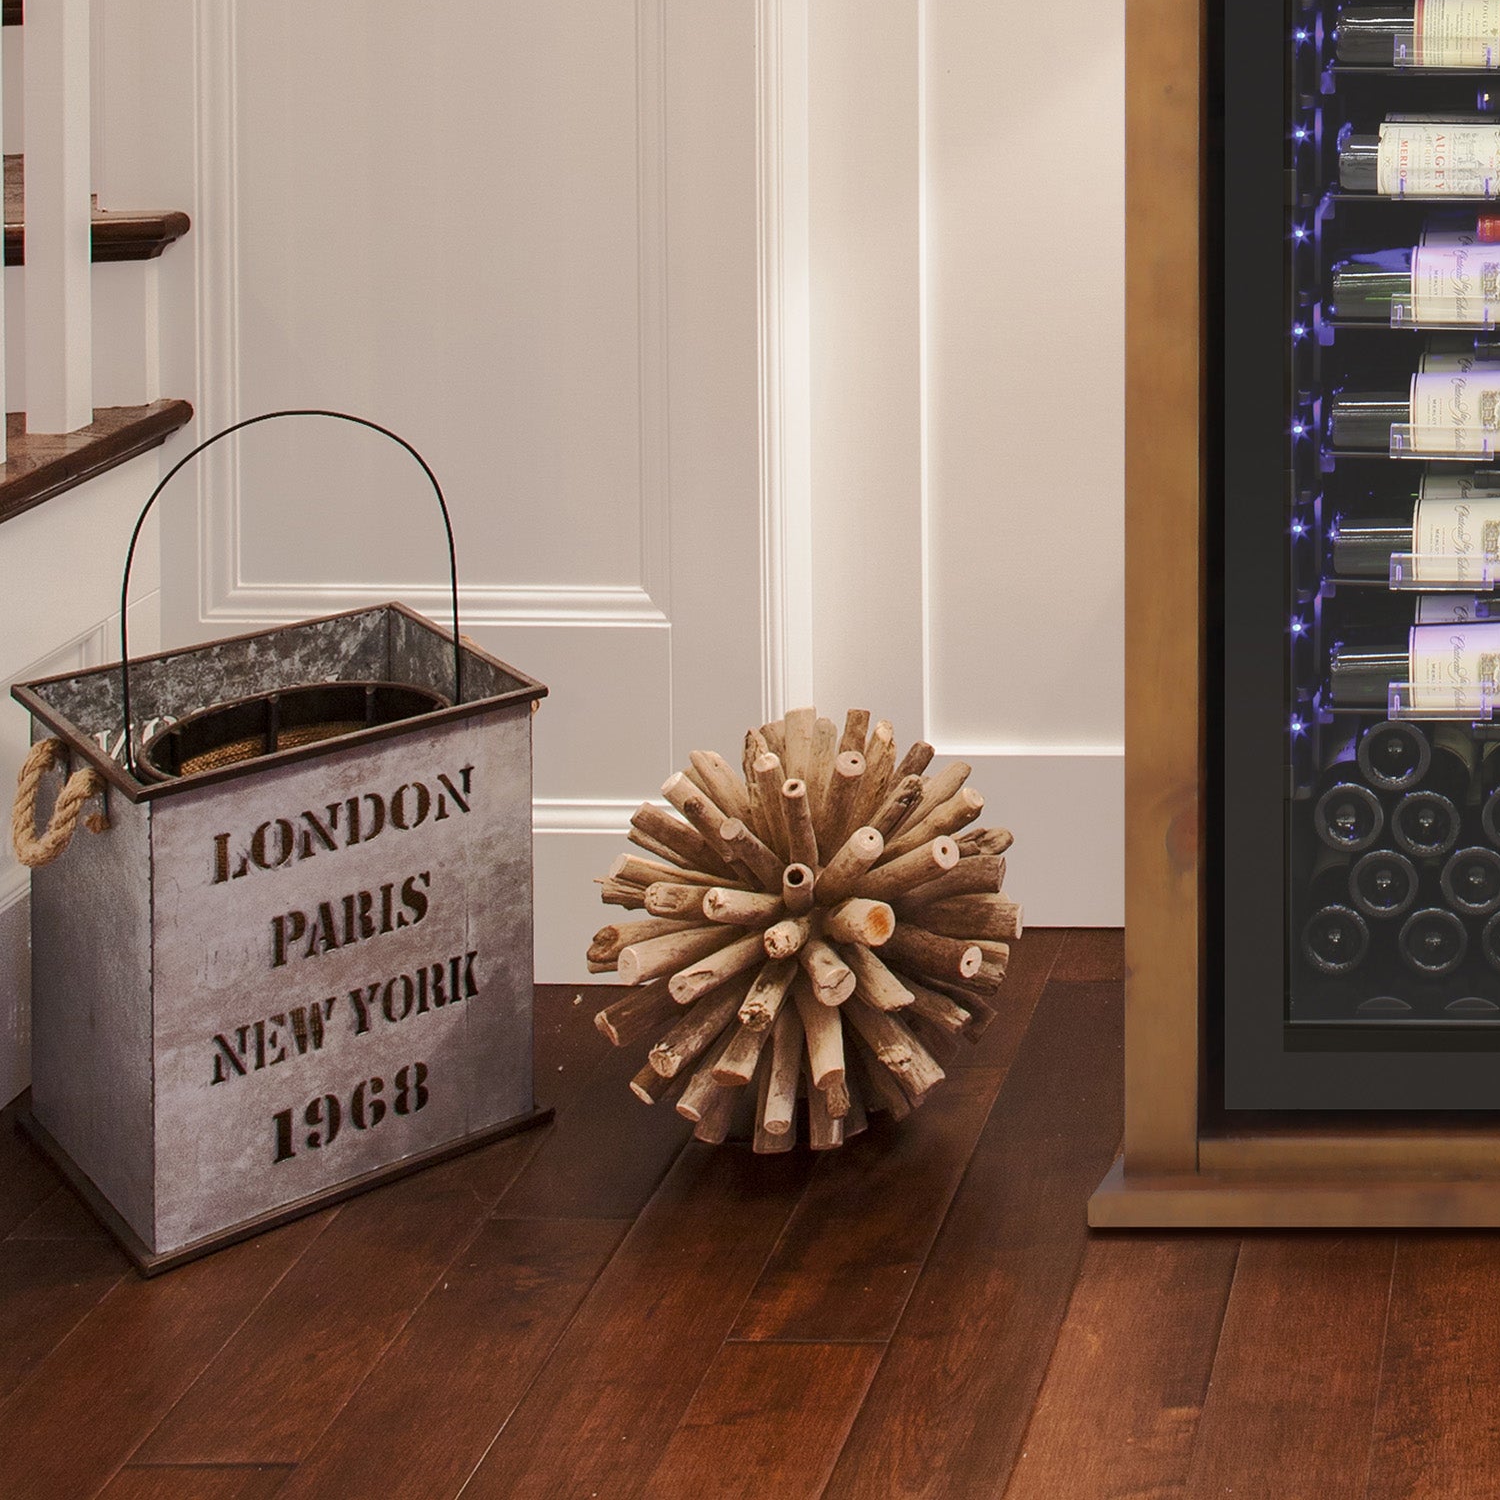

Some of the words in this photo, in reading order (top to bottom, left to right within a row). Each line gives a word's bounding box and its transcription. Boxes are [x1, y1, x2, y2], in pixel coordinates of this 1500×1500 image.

[1400, 140, 1409, 184] MERLO
[1434, 133, 1446, 190] AUGEY
[1450, 635, 1466, 675] Chateau
[212, 766, 474, 884] LONDON
[272, 871, 431, 968] PARIS
[210, 997, 338, 1086] NEW
[348, 952, 480, 1036] YORK
[272, 1061, 430, 1163] 1968
